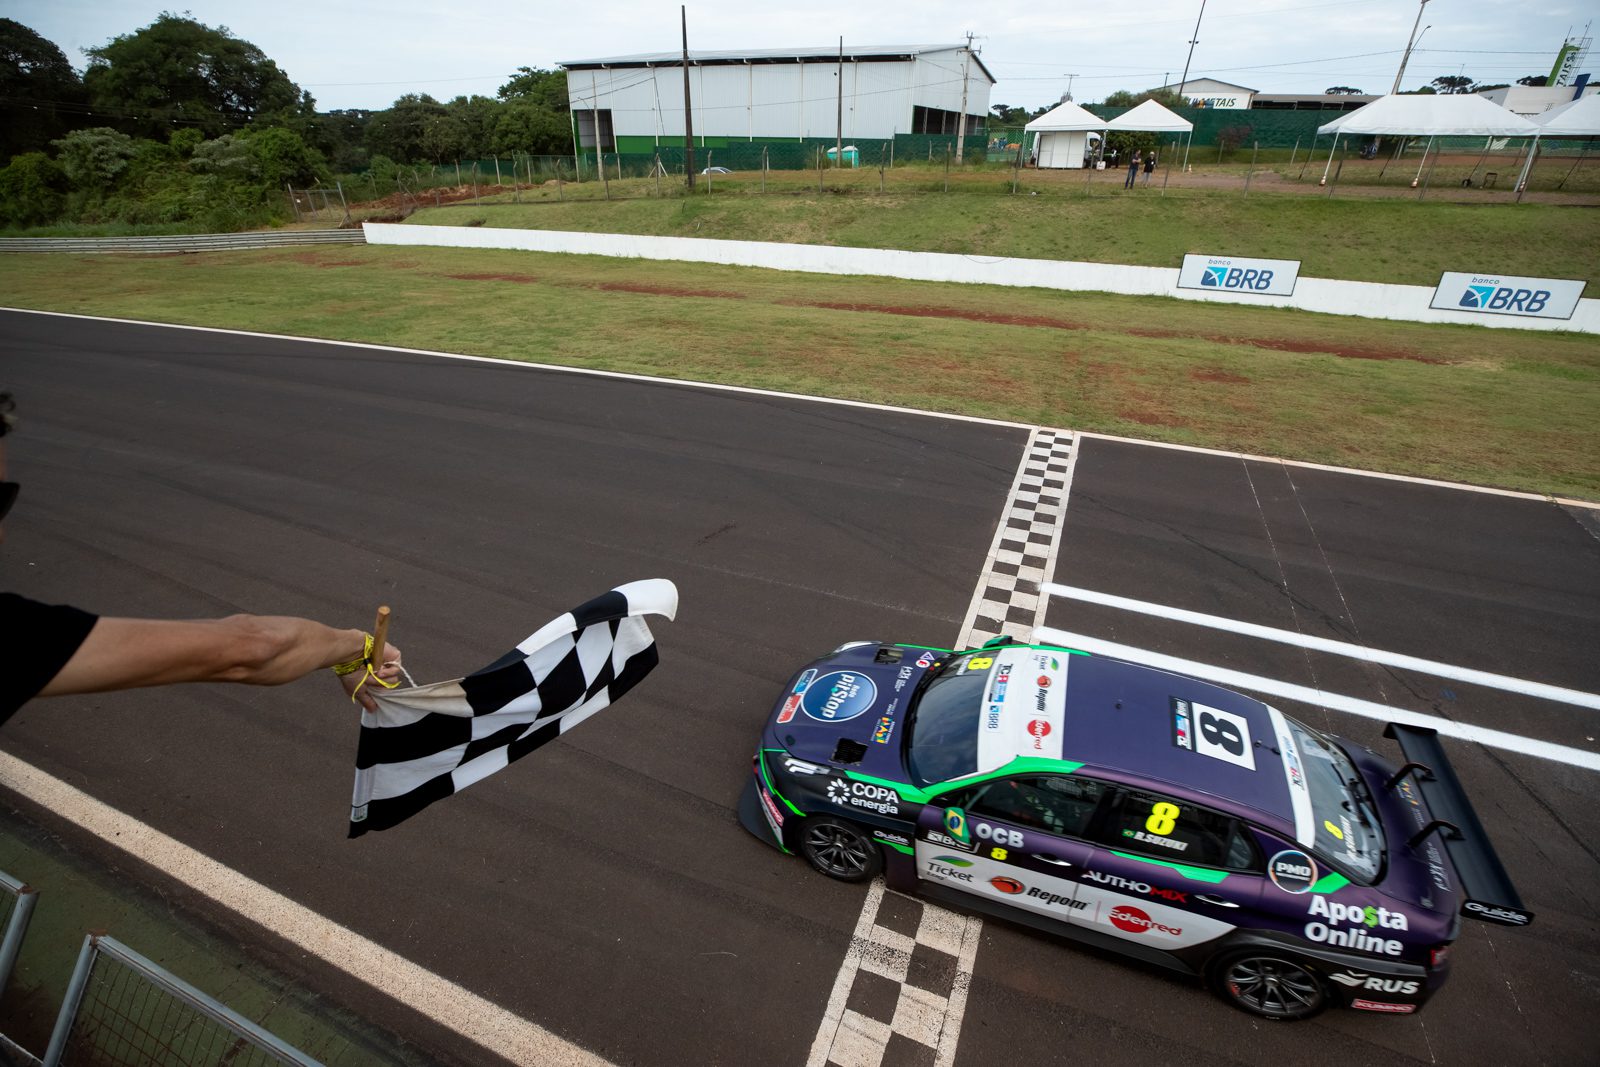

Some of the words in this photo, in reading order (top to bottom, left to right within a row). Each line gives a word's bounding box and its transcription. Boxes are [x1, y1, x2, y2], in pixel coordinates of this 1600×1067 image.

[1225, 268, 1274, 290] BRB
[1471, 277, 1500, 285] banco
[1488, 287, 1551, 312] BRB
[967, 657, 993, 670] 8
[1035, 688, 1048, 712] Repom
[988, 713, 999, 729] BRB
[1200, 711, 1244, 756] 8
[852, 782, 899, 804] COPA
[851, 796, 898, 815] energia
[1145, 801, 1180, 835] 8
[975, 823, 1025, 848] OCB
[990, 847, 1008, 860] 8
[927, 861, 974, 882] Ticket
[1027, 886, 1089, 910] Repom
[1081, 870, 1190, 903] AUTHOMIX
[1108, 909, 1182, 936] Edenred
[1304, 922, 1404, 956] Online
[1364, 977, 1420, 995] RUS
